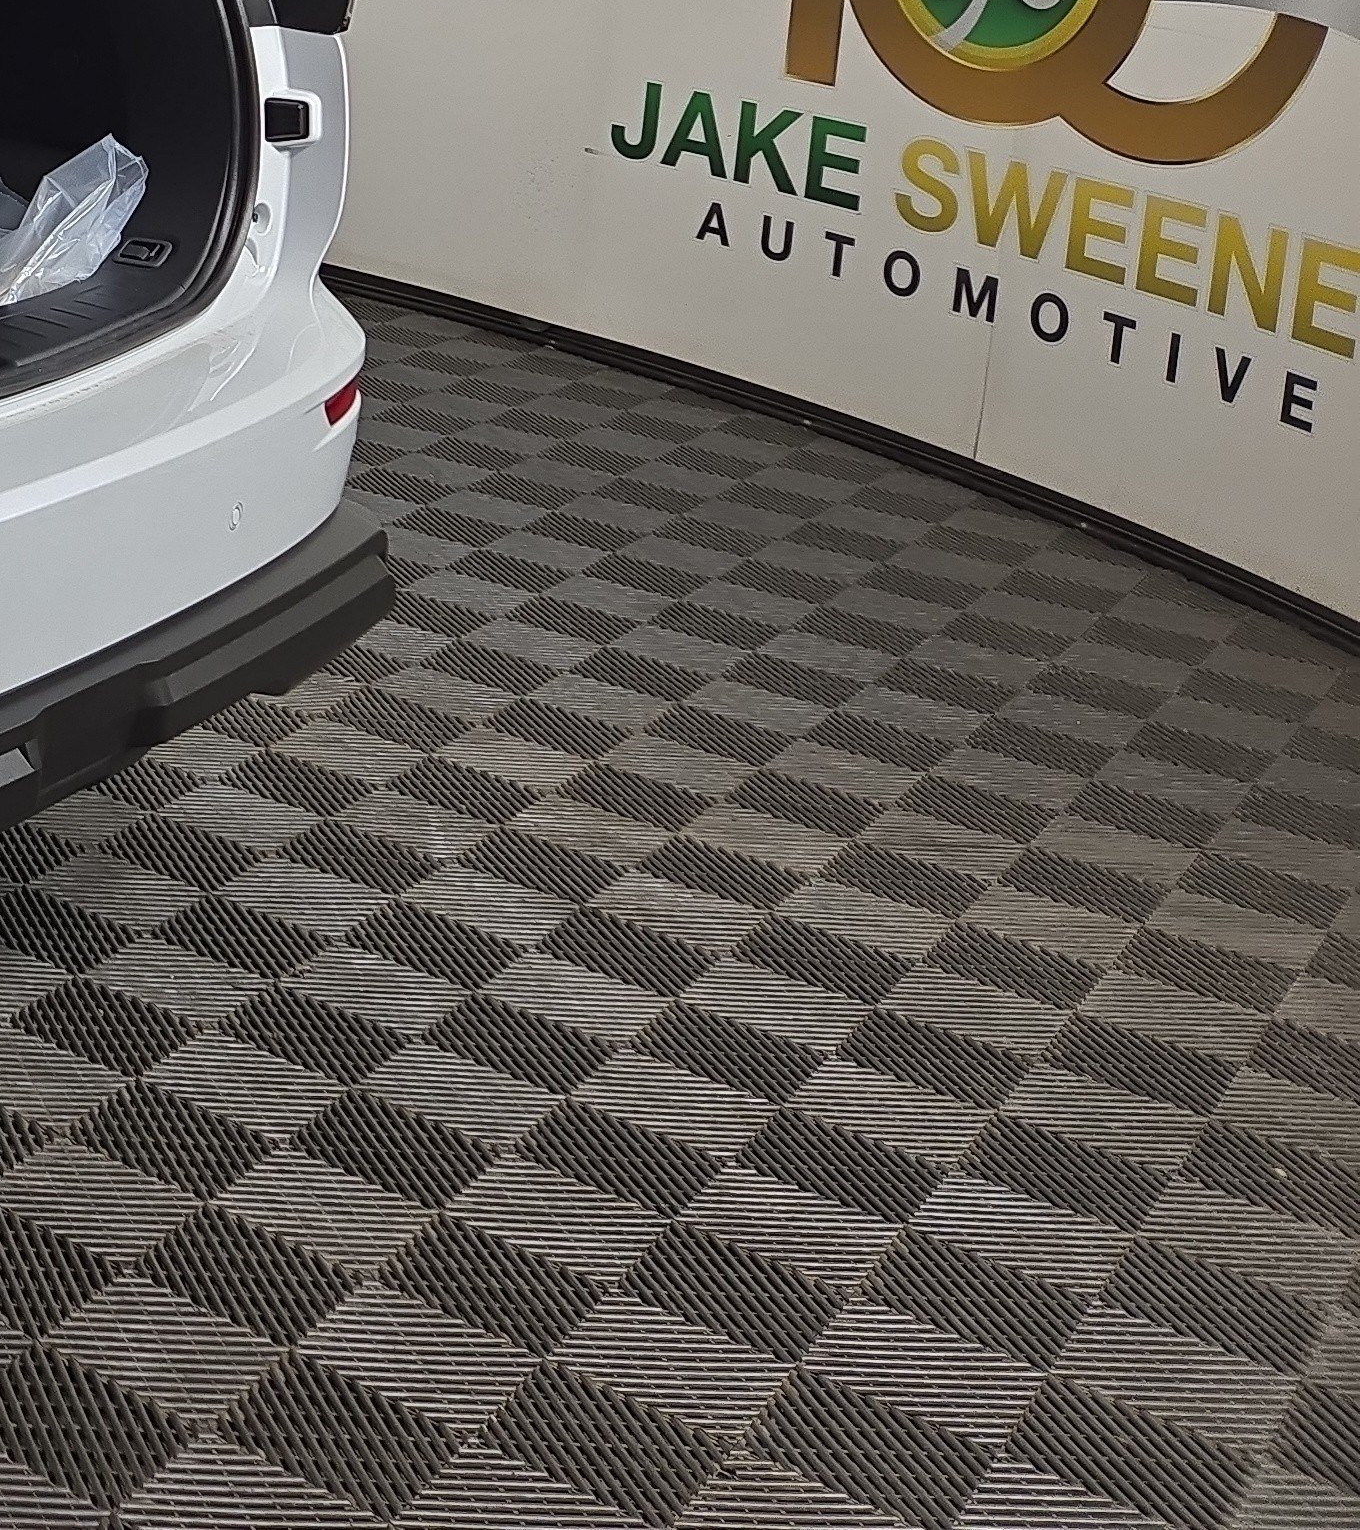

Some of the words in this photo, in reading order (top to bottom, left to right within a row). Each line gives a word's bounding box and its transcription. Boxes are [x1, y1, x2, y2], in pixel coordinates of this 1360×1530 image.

[611, 81, 868, 212] JAKE
[895, 139, 1360, 360] SWEENE
[696, 201, 1319, 433] AUTOMOTIVE
